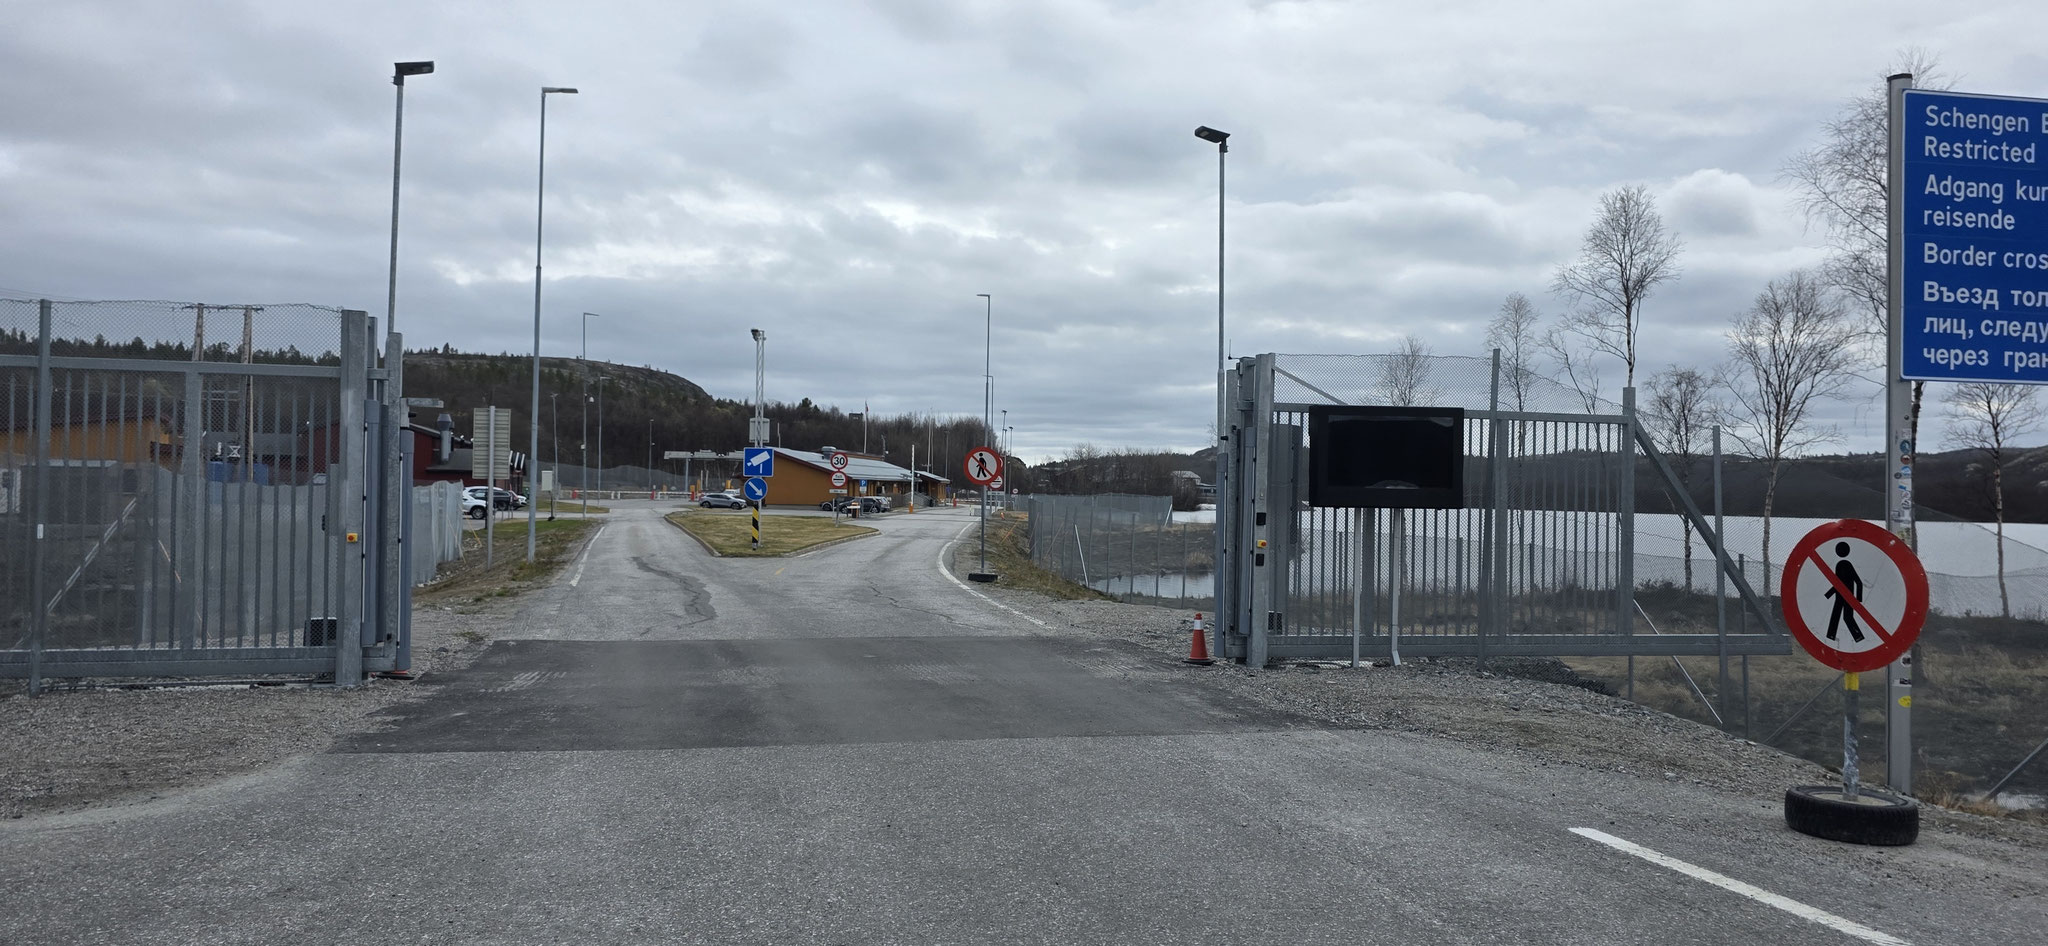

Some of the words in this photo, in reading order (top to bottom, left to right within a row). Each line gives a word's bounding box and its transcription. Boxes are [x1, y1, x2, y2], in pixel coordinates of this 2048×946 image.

[1925, 105, 2029, 135] Schengen
[1924, 136, 2035, 163] Restricted
[1924, 174, 2004, 204] Adgang
[1923, 205, 2015, 230] reisende
[1924, 242, 1997, 267] Border
[2003, 252, 2048, 270] cros
[1923, 280, 1999, 311] Въезд
[1923, 316, 1974, 340] лиц,
[1923, 347, 1989, 371] через
[834, 456, 845, 465] 30
